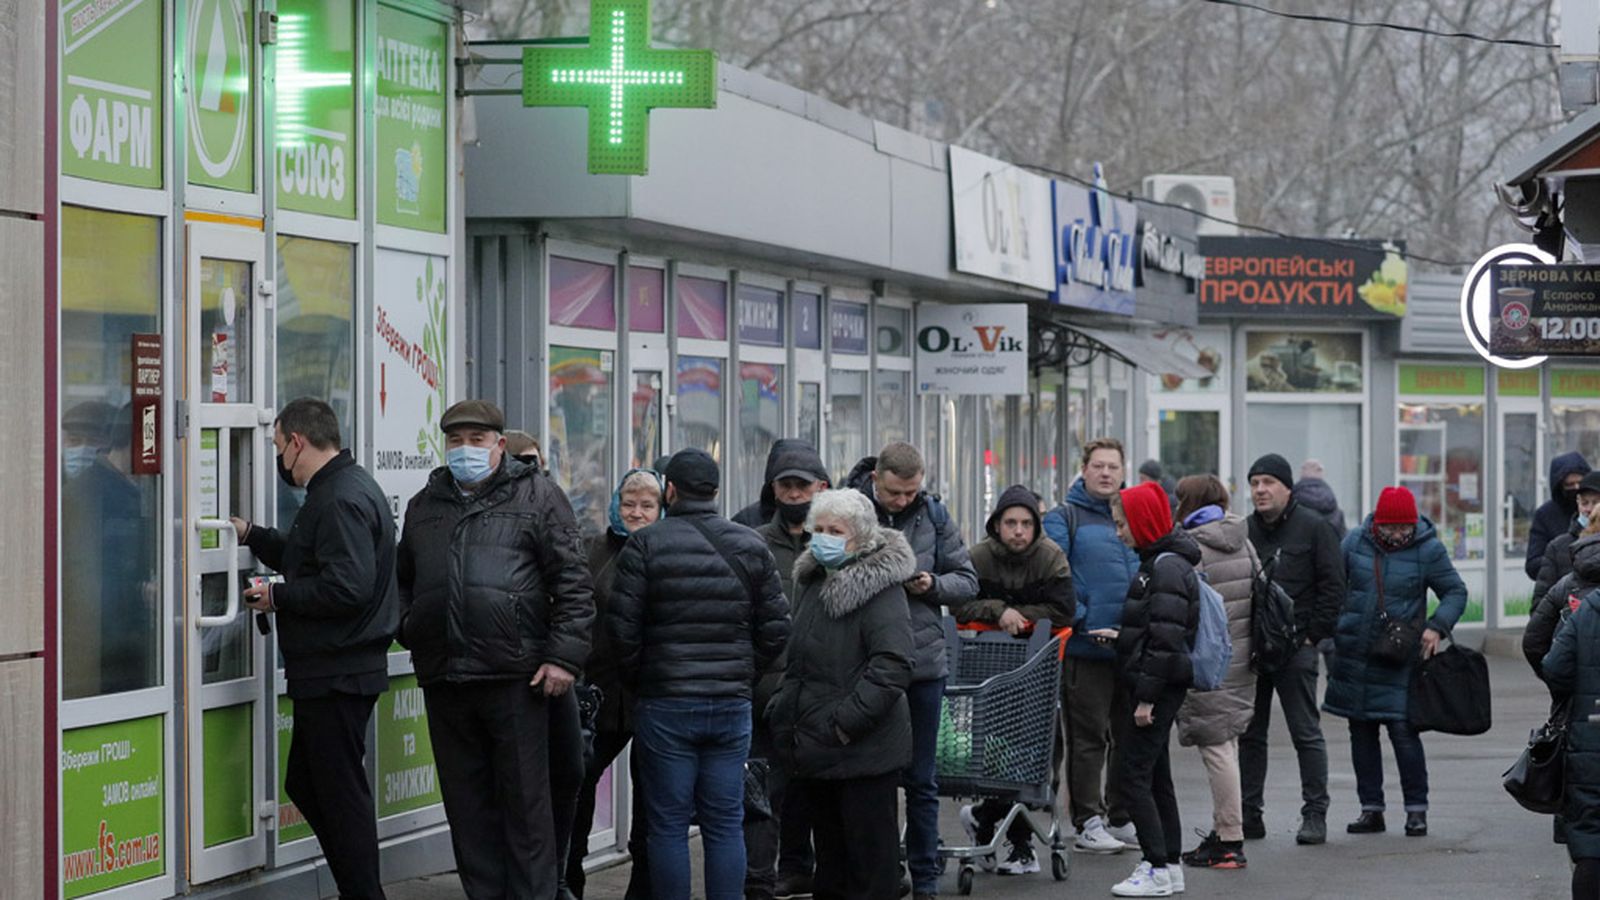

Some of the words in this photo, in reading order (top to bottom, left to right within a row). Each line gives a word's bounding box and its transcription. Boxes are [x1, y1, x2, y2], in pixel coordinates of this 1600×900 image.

[377, 36, 441, 93] АПТЕКА
[69, 93, 151, 169] ФАРМ
[280, 142, 345, 200] СОЮЗ
[1500, 270, 1569, 282] ЗЕРНОВА
[1200, 280, 1353, 305] ПРОДУКТИ
[1543, 290, 1595, 302] Еспресо
[376, 450, 403, 470] ЗАМОВ
[62, 750, 99, 772] Збережи
[101, 740, 130, 763] ГРОШІ
[403, 732, 416, 756] та
[102, 780, 129, 807] ЗАМОВ
[385, 763, 435, 803] ЗНИЖКИ
[63, 819, 160, 883] www.fs.com.ua
